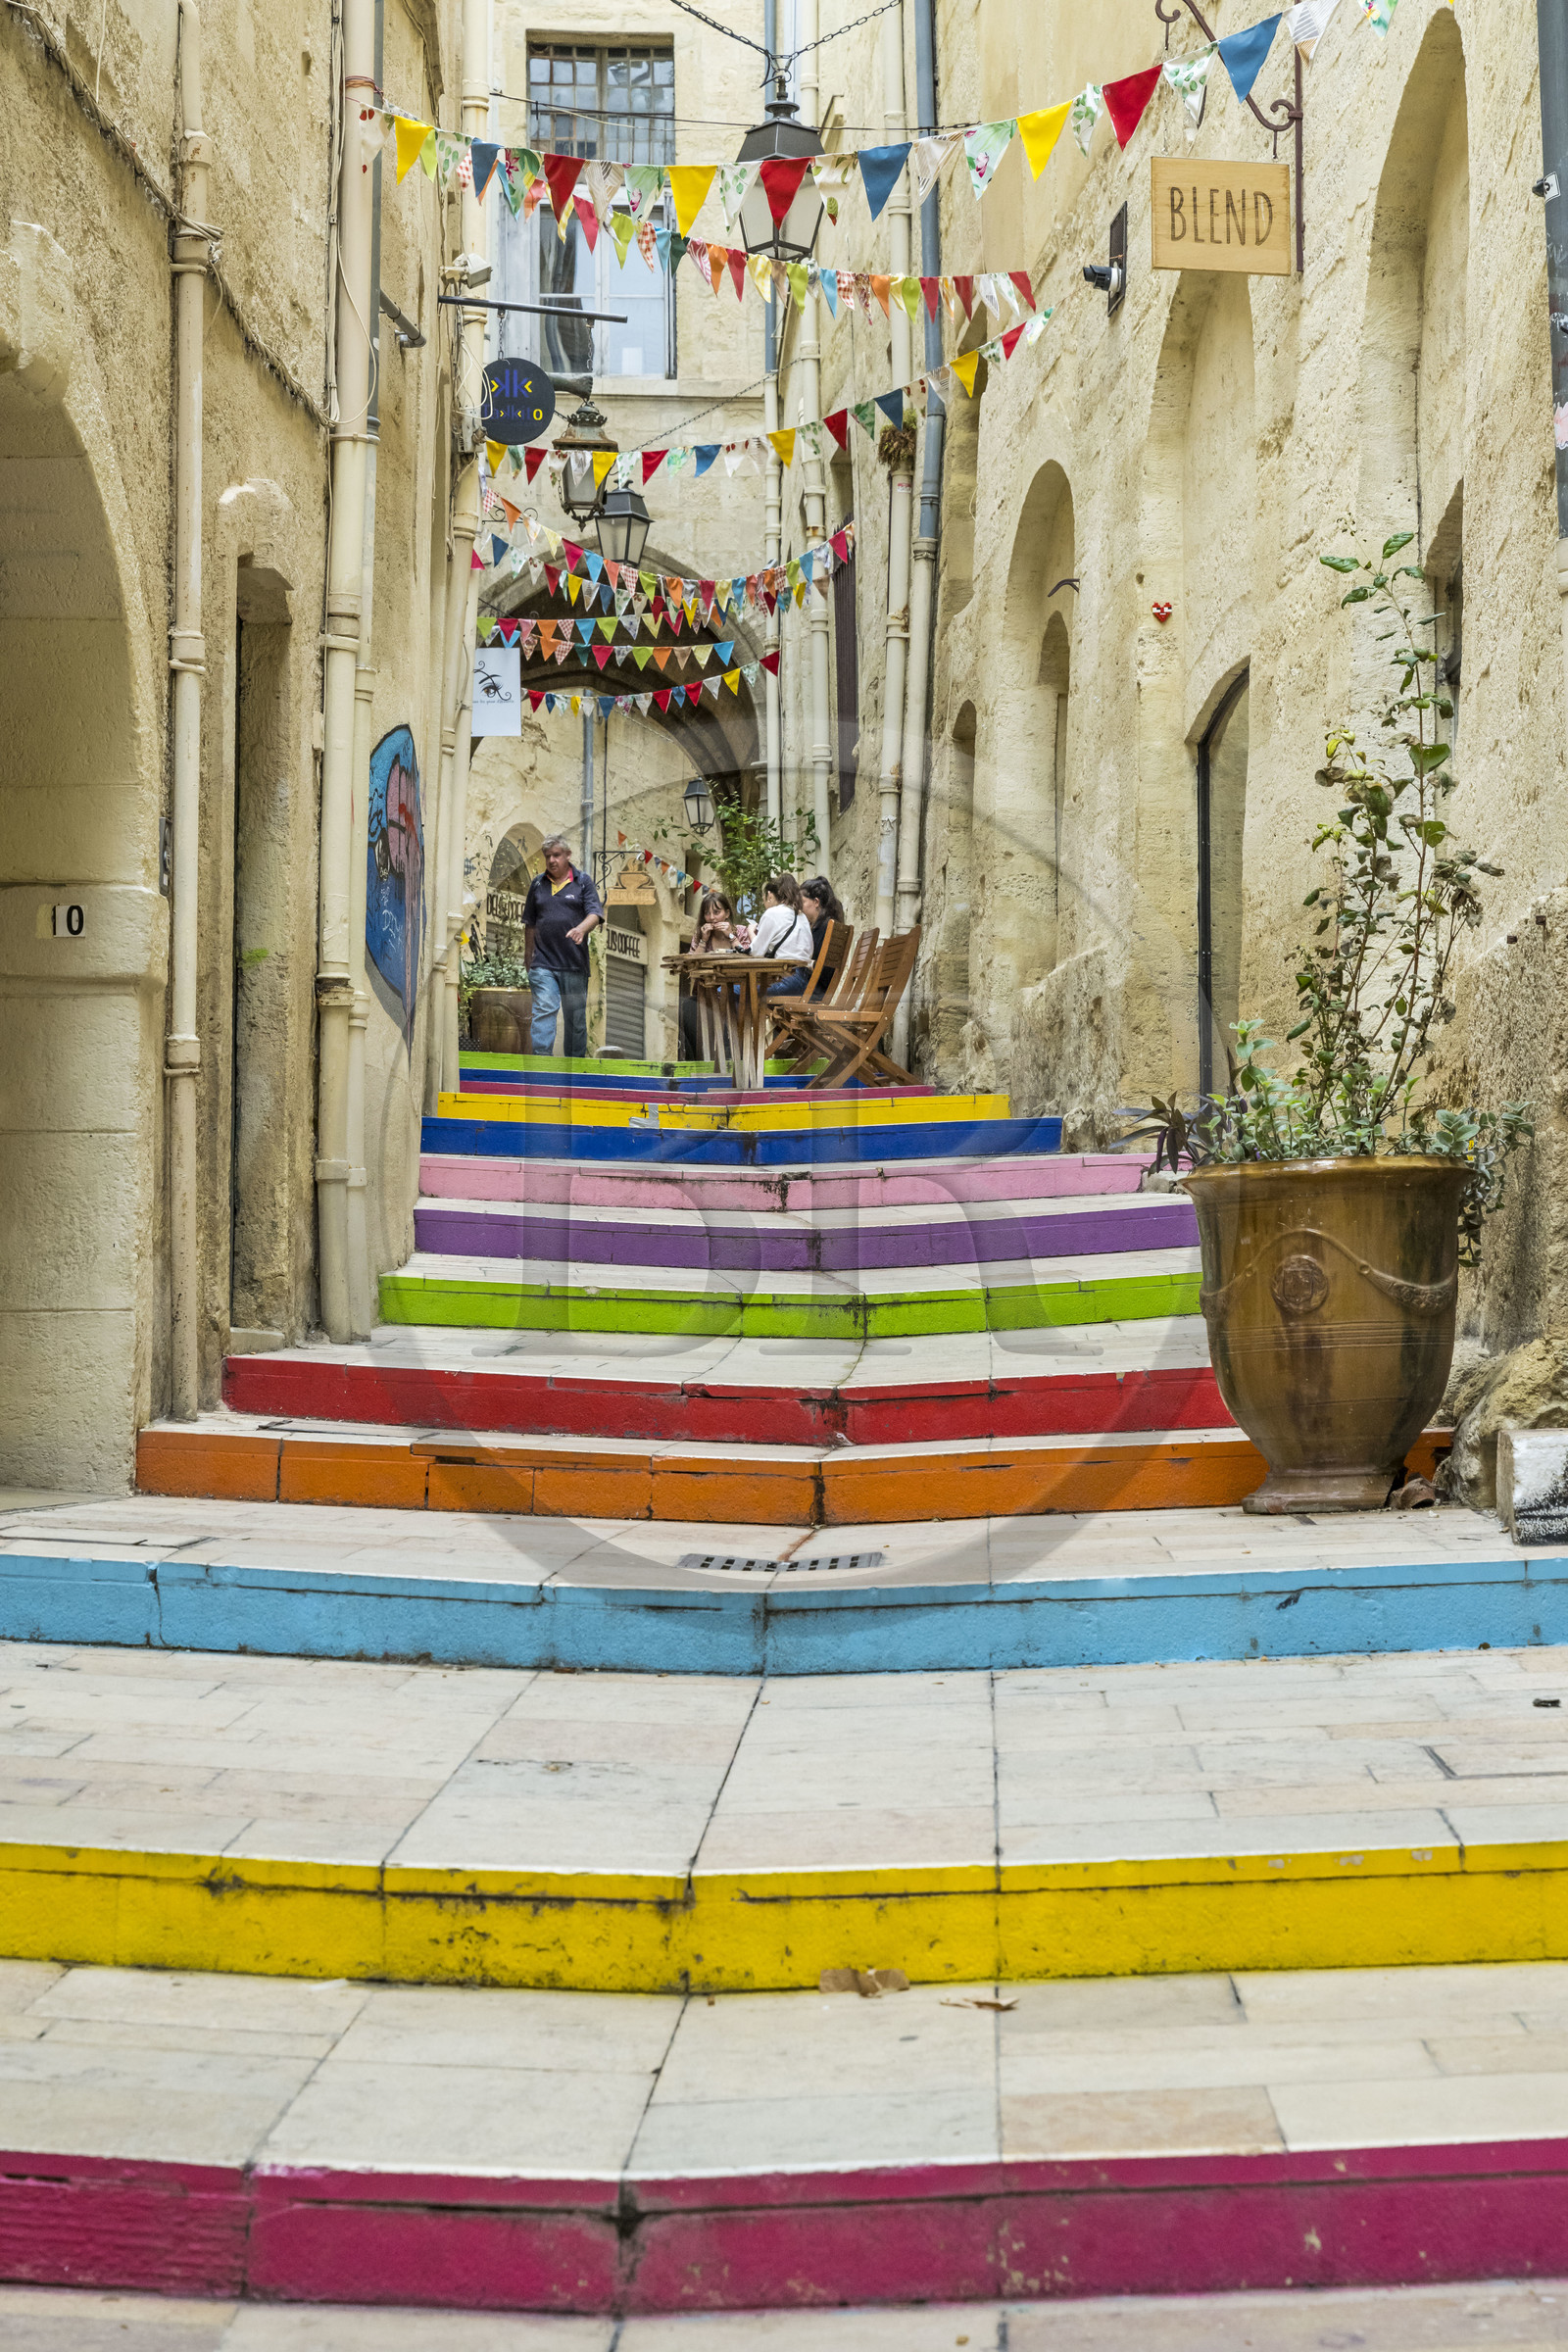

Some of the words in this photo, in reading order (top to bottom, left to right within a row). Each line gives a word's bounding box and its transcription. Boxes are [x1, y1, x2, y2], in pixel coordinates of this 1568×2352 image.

[1170, 186, 1273, 246] BLEND
[51, 905, 84, 936] 10
[486, 893, 507, 920] DEL
[617, 932, 641, 959] COFFEE
